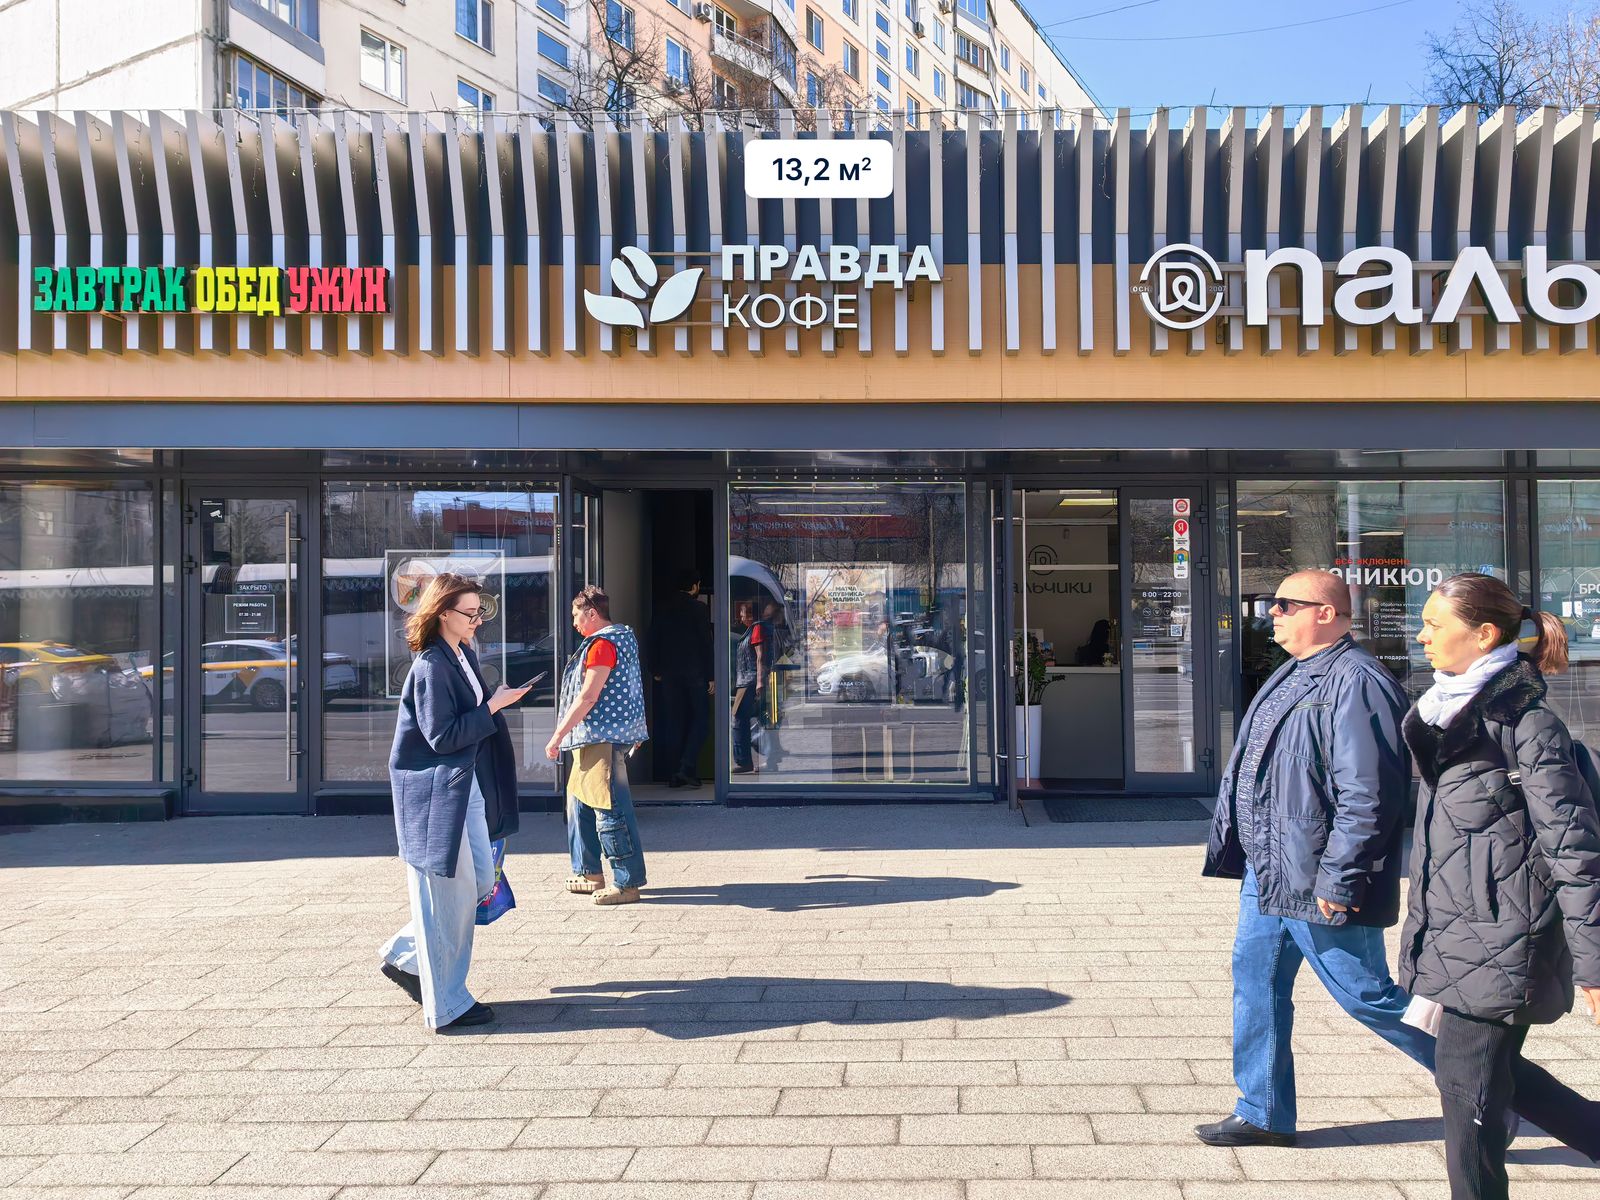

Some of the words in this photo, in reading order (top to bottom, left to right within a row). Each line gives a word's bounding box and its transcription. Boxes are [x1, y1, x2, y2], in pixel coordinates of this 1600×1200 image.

[721, 244, 942, 289] ПРАВДА
[1244, 245, 1600, 326] паль
[33, 266, 187, 312] ЗАВТРАК
[195, 265, 281, 317] ОБЕД
[287, 267, 389, 313] УЖИН
[722, 291, 859, 330] КОФЕ
